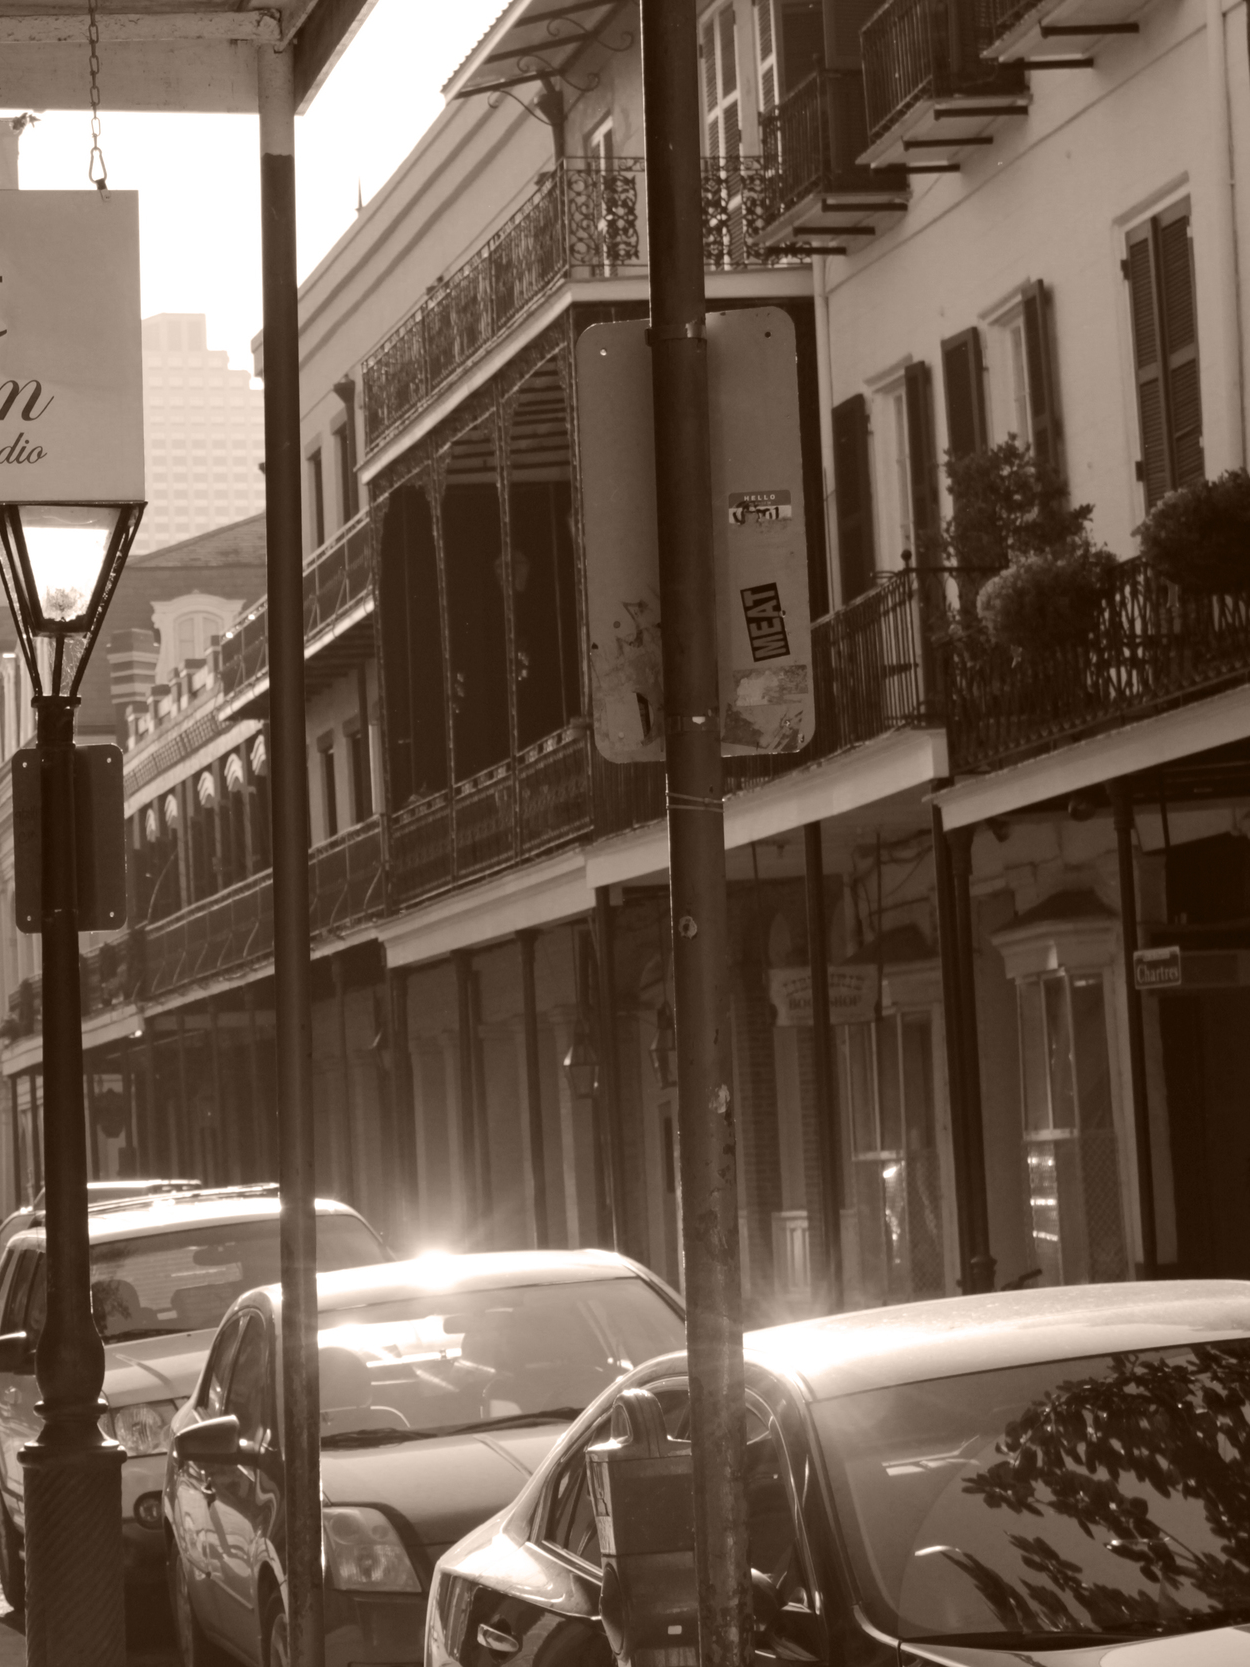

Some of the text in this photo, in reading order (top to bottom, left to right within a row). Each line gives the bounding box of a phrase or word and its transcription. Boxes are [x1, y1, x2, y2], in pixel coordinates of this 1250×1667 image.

[743, 493, 776, 502] HELLO
[743, 589, 788, 659] MEAT
[1136, 964, 1178, 984] Chartres
